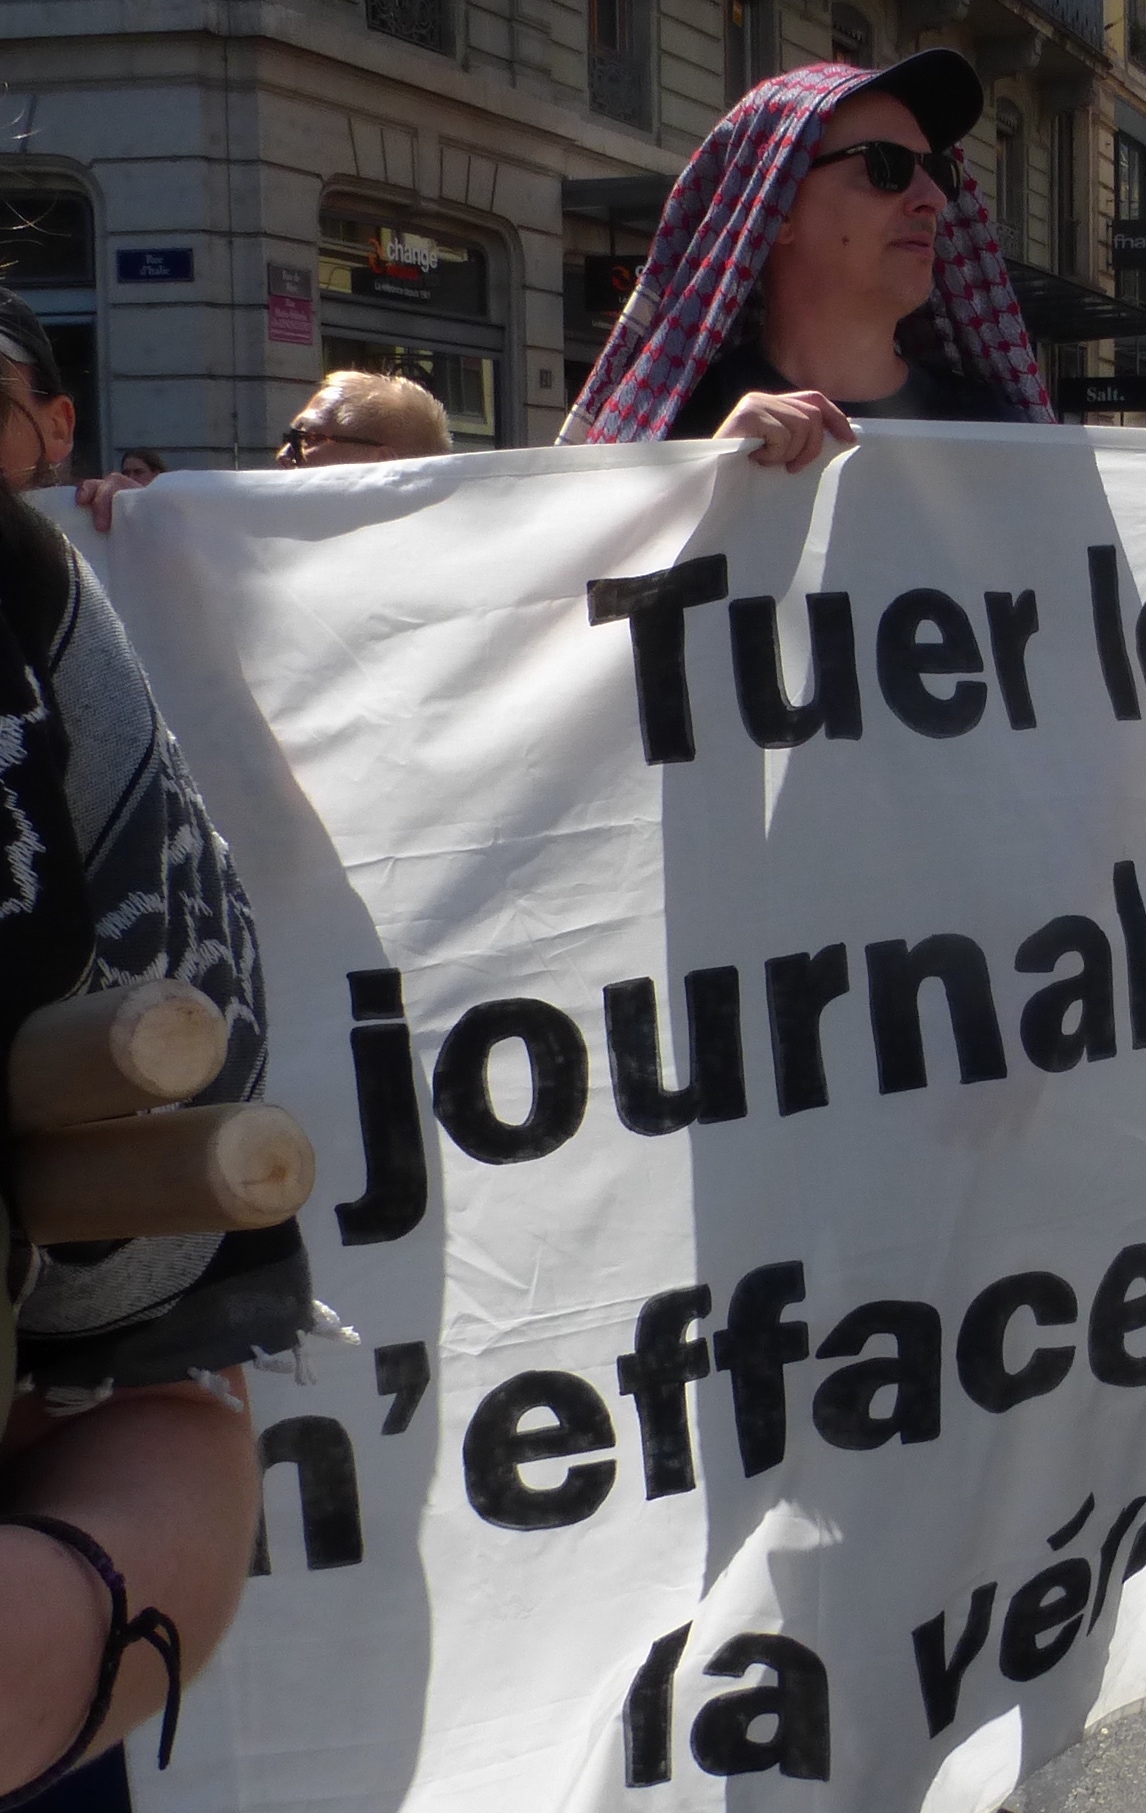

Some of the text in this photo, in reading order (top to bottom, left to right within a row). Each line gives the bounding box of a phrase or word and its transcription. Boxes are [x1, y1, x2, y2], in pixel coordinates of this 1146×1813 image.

[146, 254, 164, 264] Rue
[387, 238, 438, 273] change
[587, 554, 1039, 766] Tuer
[623, 1621, 831, 1788] la
